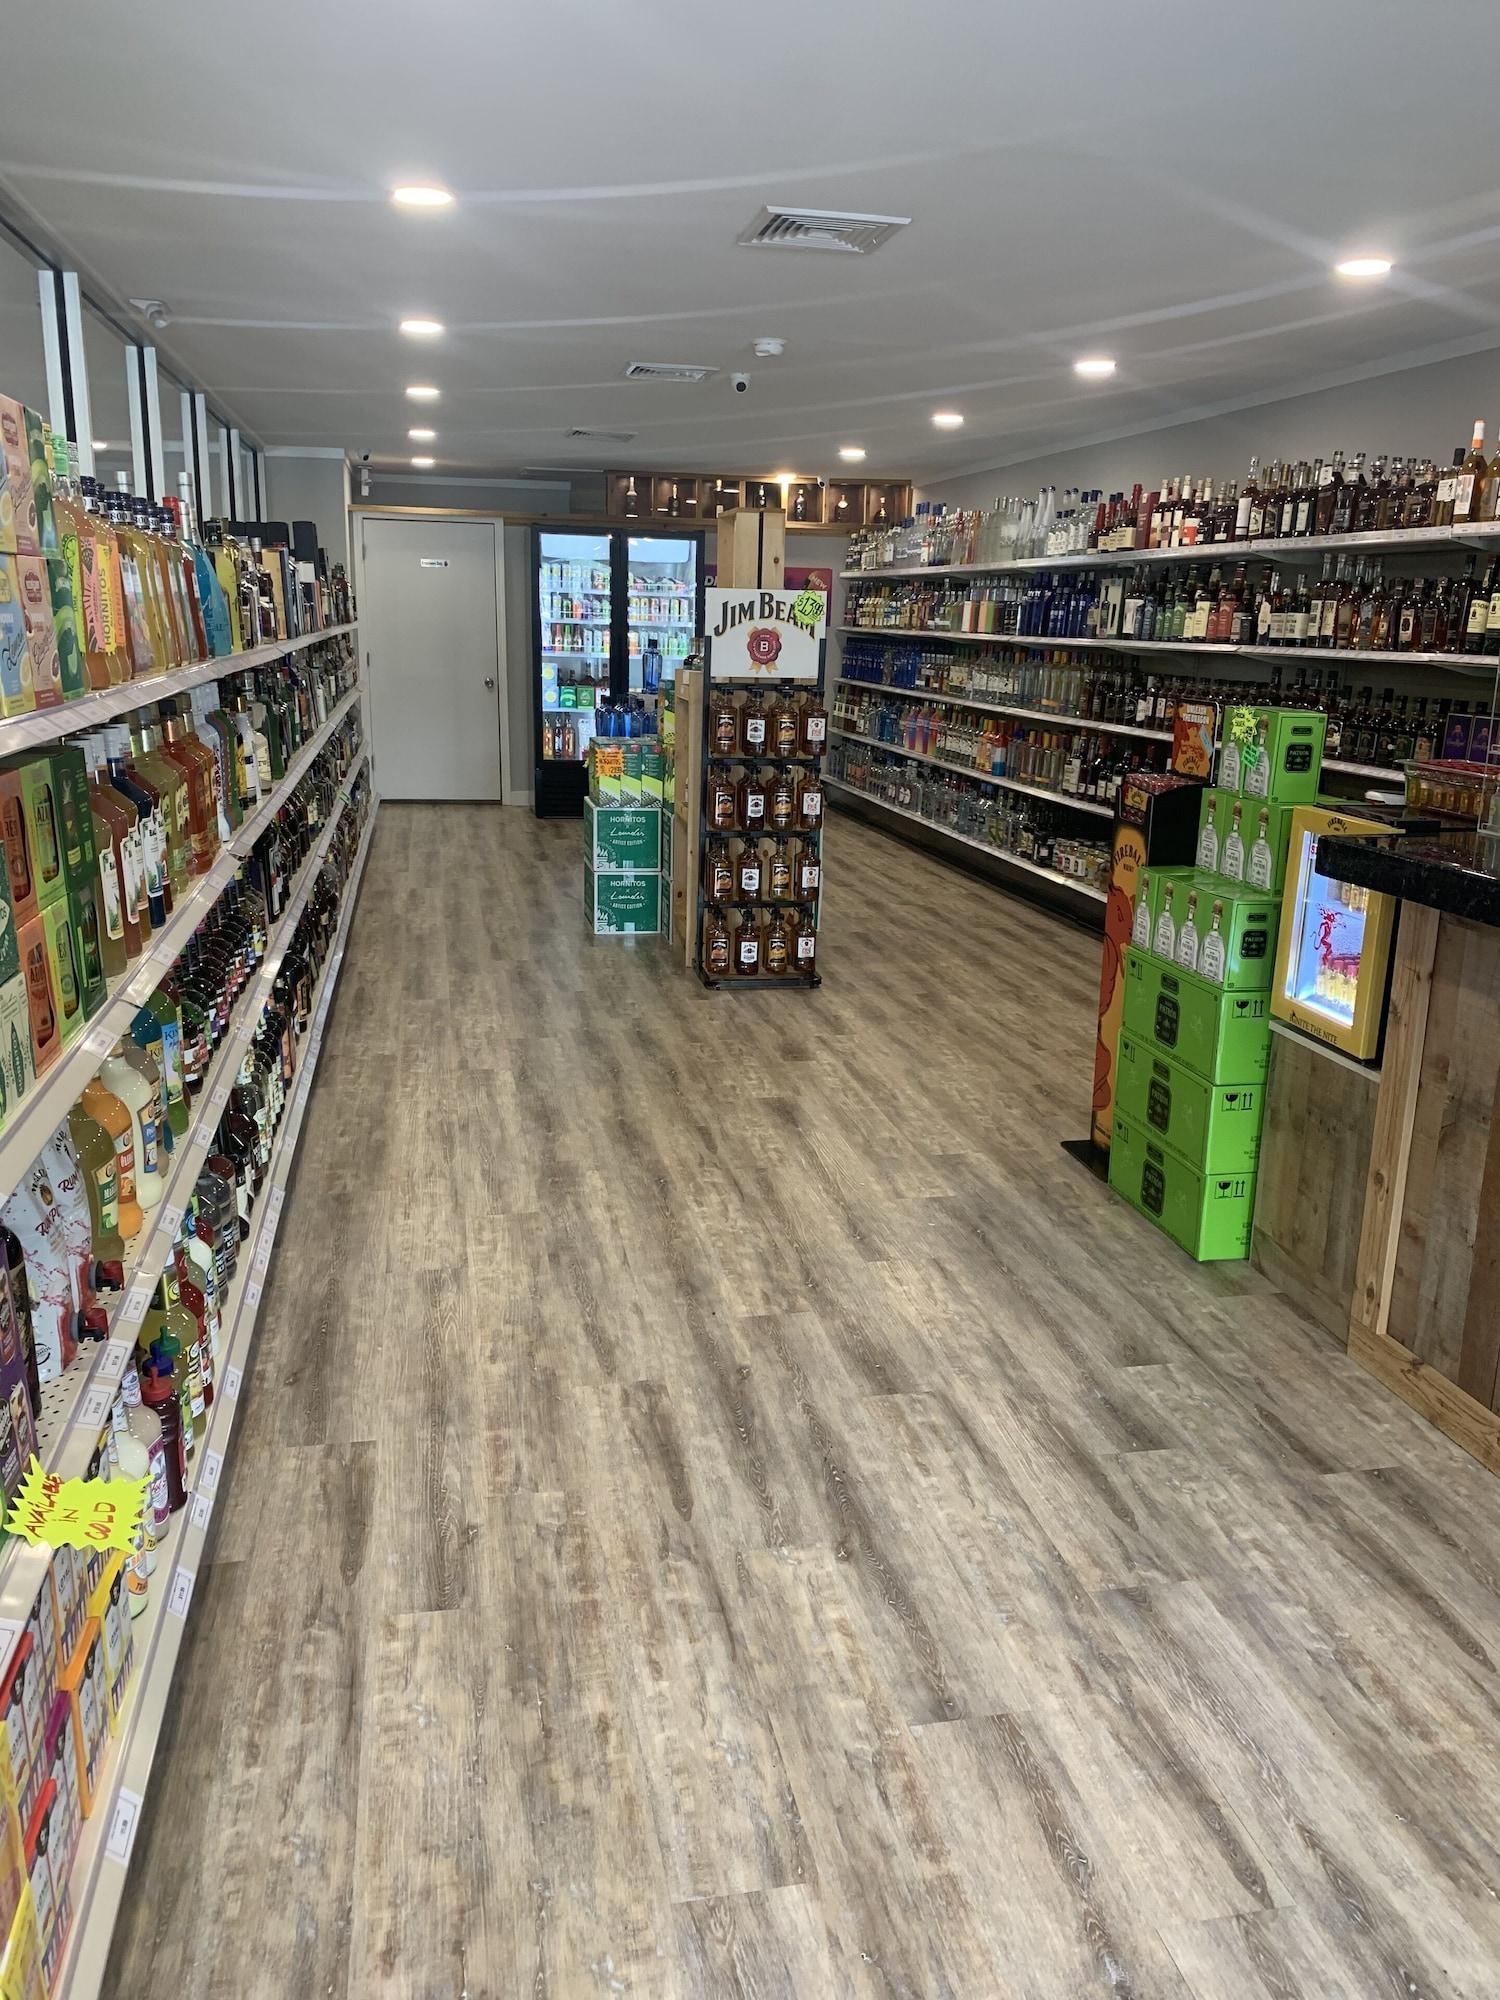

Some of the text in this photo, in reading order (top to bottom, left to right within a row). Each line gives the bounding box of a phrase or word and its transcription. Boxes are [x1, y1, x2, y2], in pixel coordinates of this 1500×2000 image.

[99, 568, 112, 645] HORNITOS
[713, 600, 756, 636] JIM
[760, 641, 769, 651] B
[1323, 1030, 1339, 1045] NITE
[24, 1475, 65, 1538] AVAILABLE
[52, 1508, 79, 1523] IN
